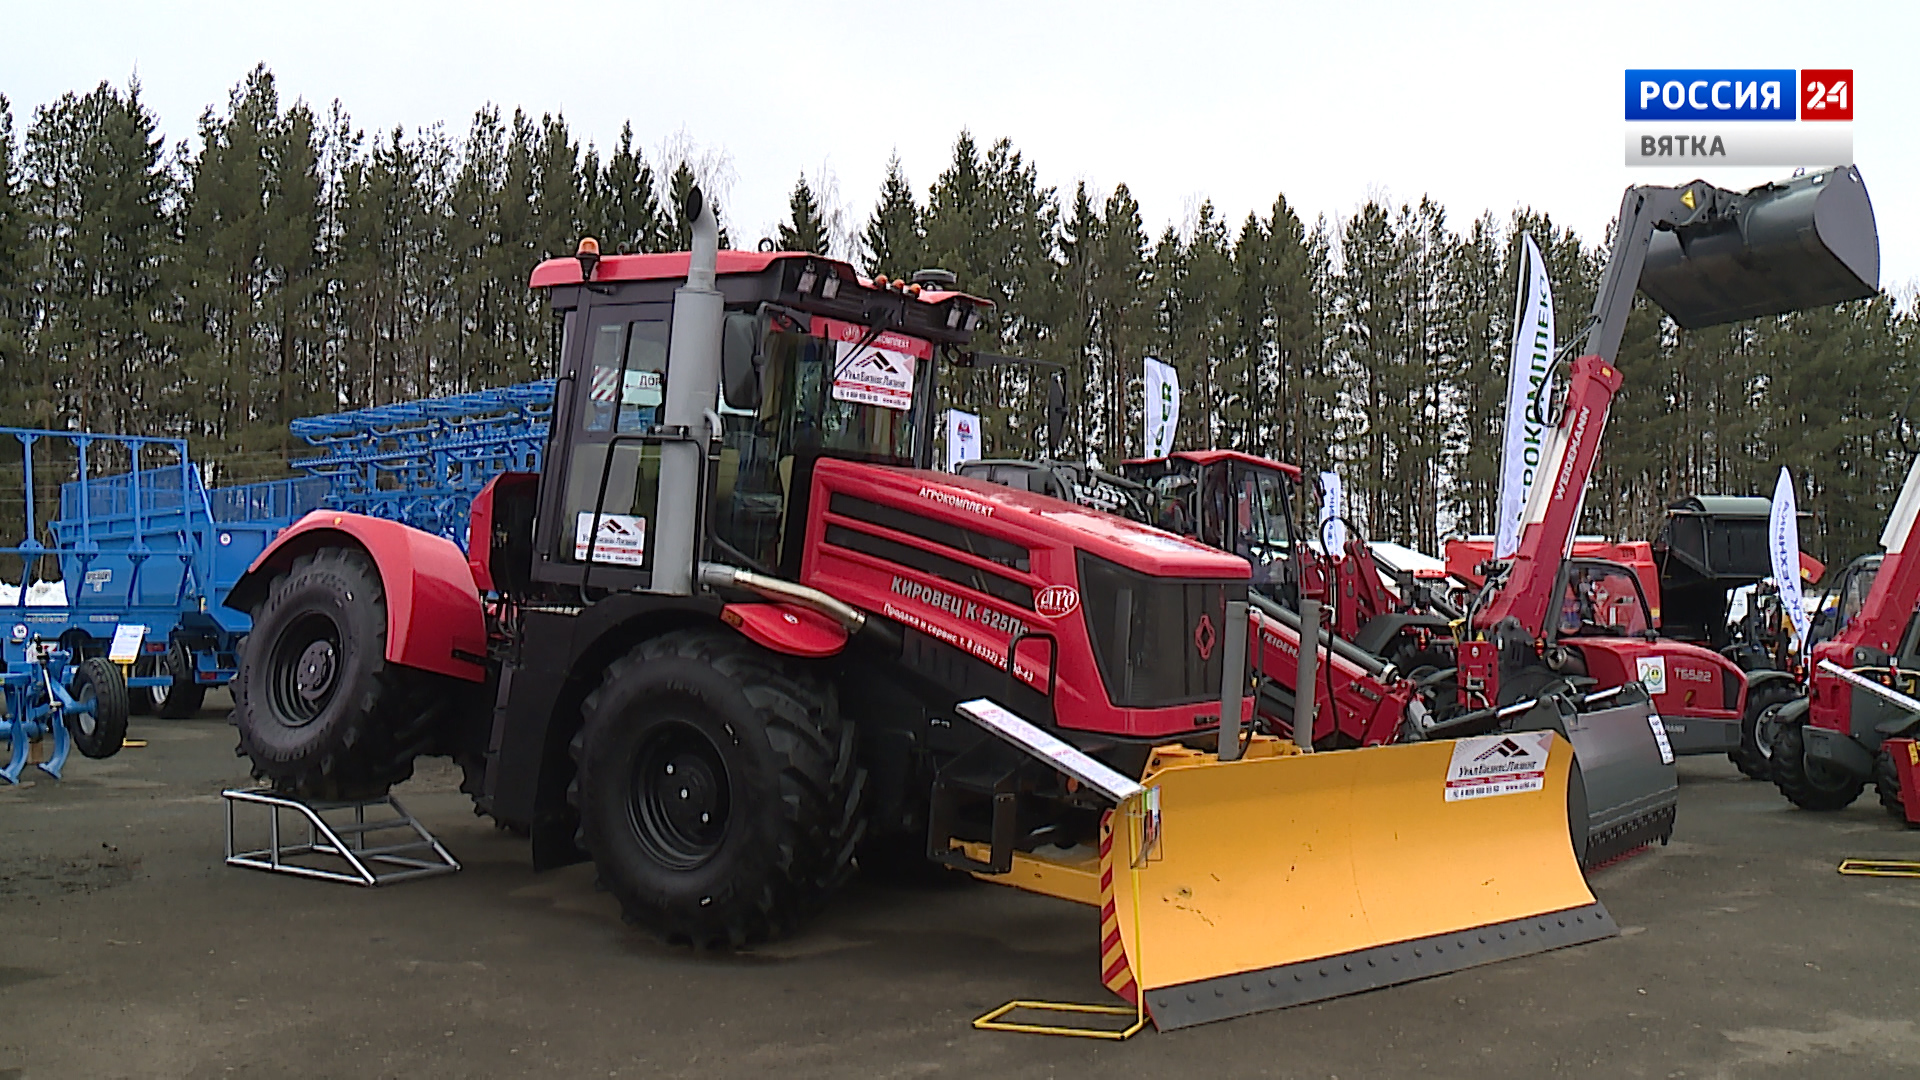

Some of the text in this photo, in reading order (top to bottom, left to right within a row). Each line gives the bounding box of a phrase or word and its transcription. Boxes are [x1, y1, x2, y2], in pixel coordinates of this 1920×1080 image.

[1555, 406, 1590, 500] WEIDEMANN
[919, 487, 994, 517] АГРОКОМПЛЕКТ
[891, 576, 963, 618] КИРОВЕЦ
[883, 602, 919, 626] Продажа
[920, 620, 926, 629] и
[927, 623, 958, 643] сервис
[966, 639, 973, 649] 8
